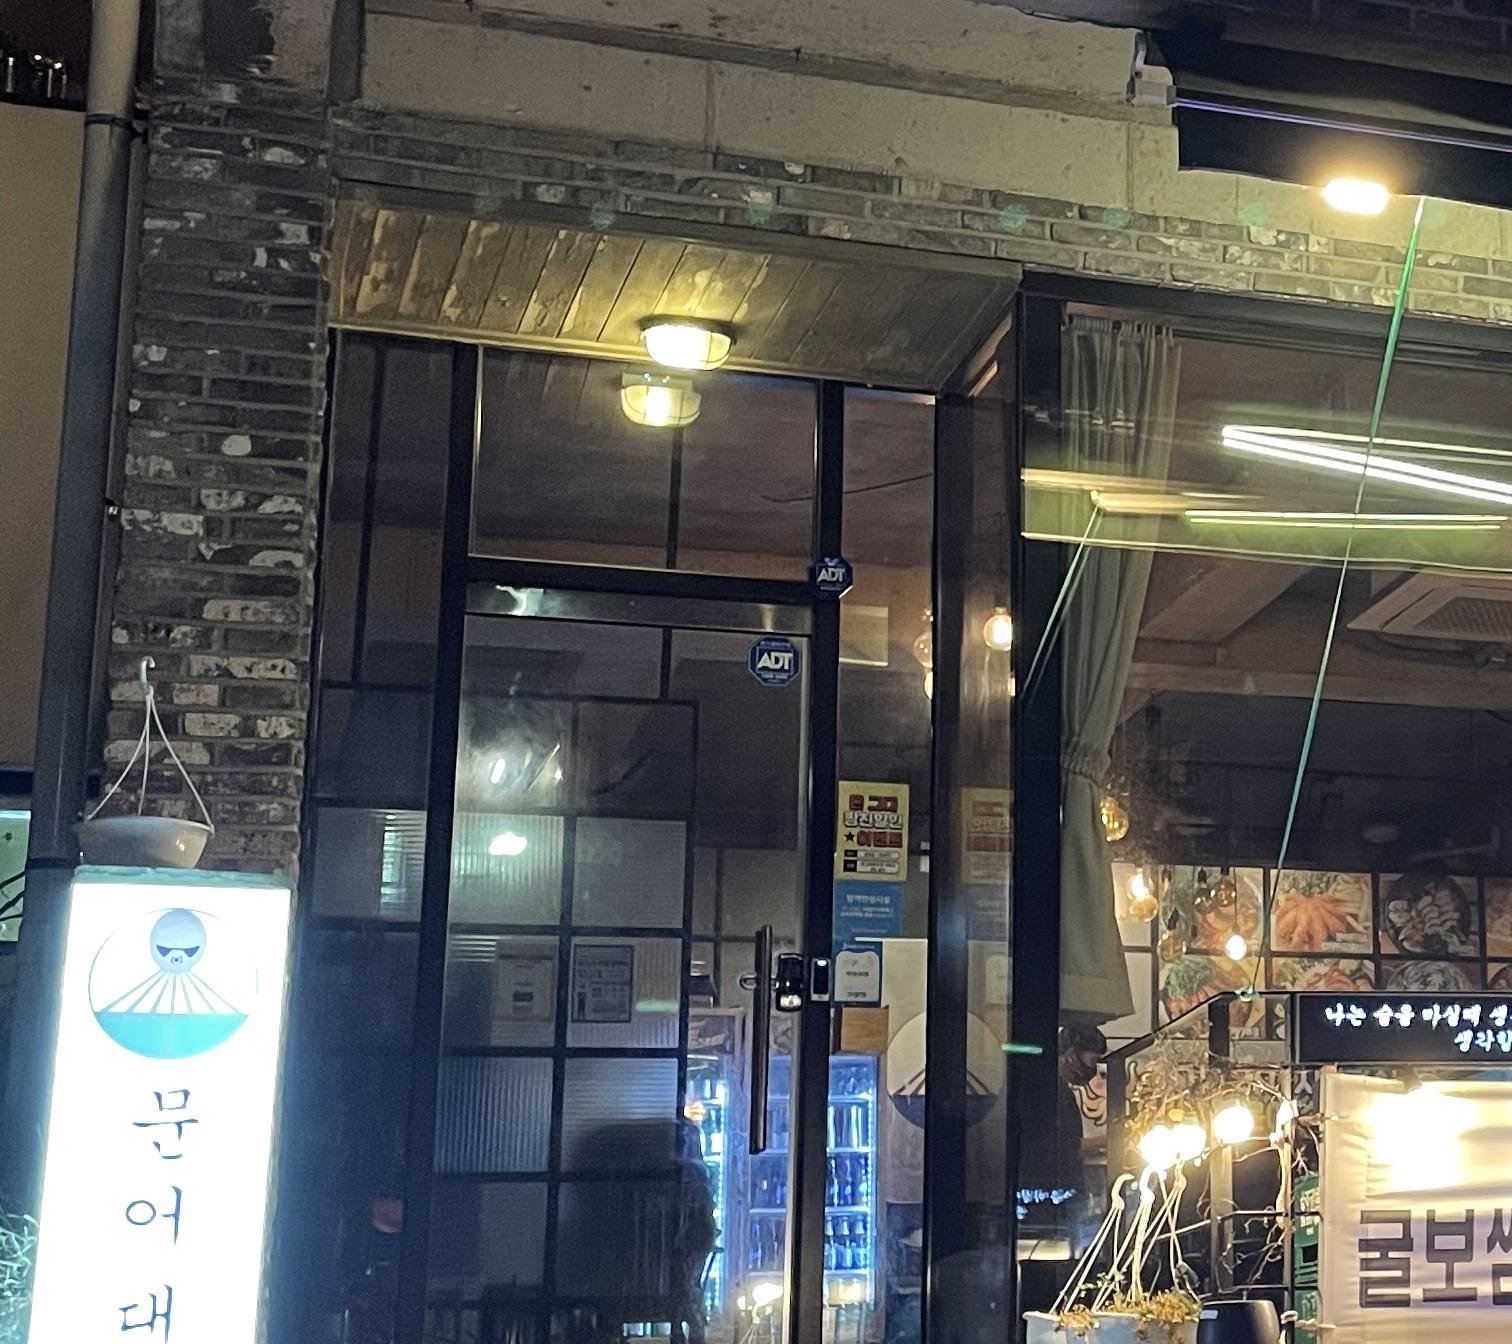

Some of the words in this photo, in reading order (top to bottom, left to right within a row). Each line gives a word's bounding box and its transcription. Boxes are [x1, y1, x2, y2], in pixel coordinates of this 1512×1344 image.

[816, 567, 846, 583] ADT
[755, 651, 793, 670] ADT
[1325, 1002, 1367, 1027] 나는
[1373, 1003, 1416, 1027] 술을
